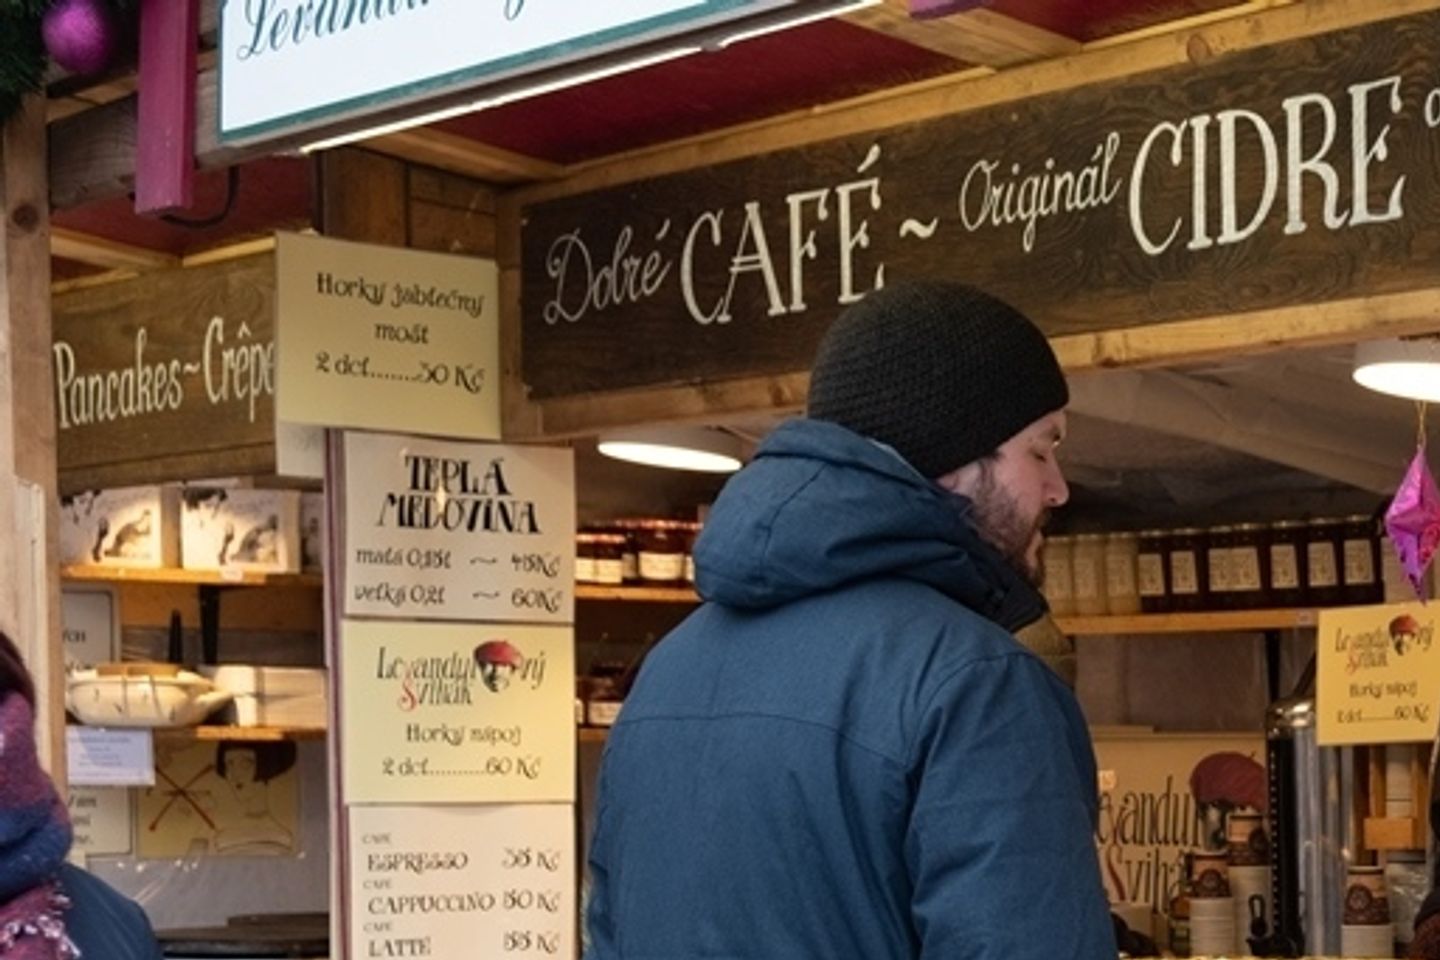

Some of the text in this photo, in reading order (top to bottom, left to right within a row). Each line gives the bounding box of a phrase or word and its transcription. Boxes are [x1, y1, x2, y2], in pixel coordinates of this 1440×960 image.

[543, 218, 676, 325] Dobré
[680, 143, 885, 325] CAFÉ
[957, 130, 1121, 254] Originál
[1128, 75, 1404, 256] CIDRE
[375, 493, 543, 535] MEDOVINA
[367, 851, 469, 875] ESPRESSO
[367, 891, 497, 915] CAPPUCCINO
